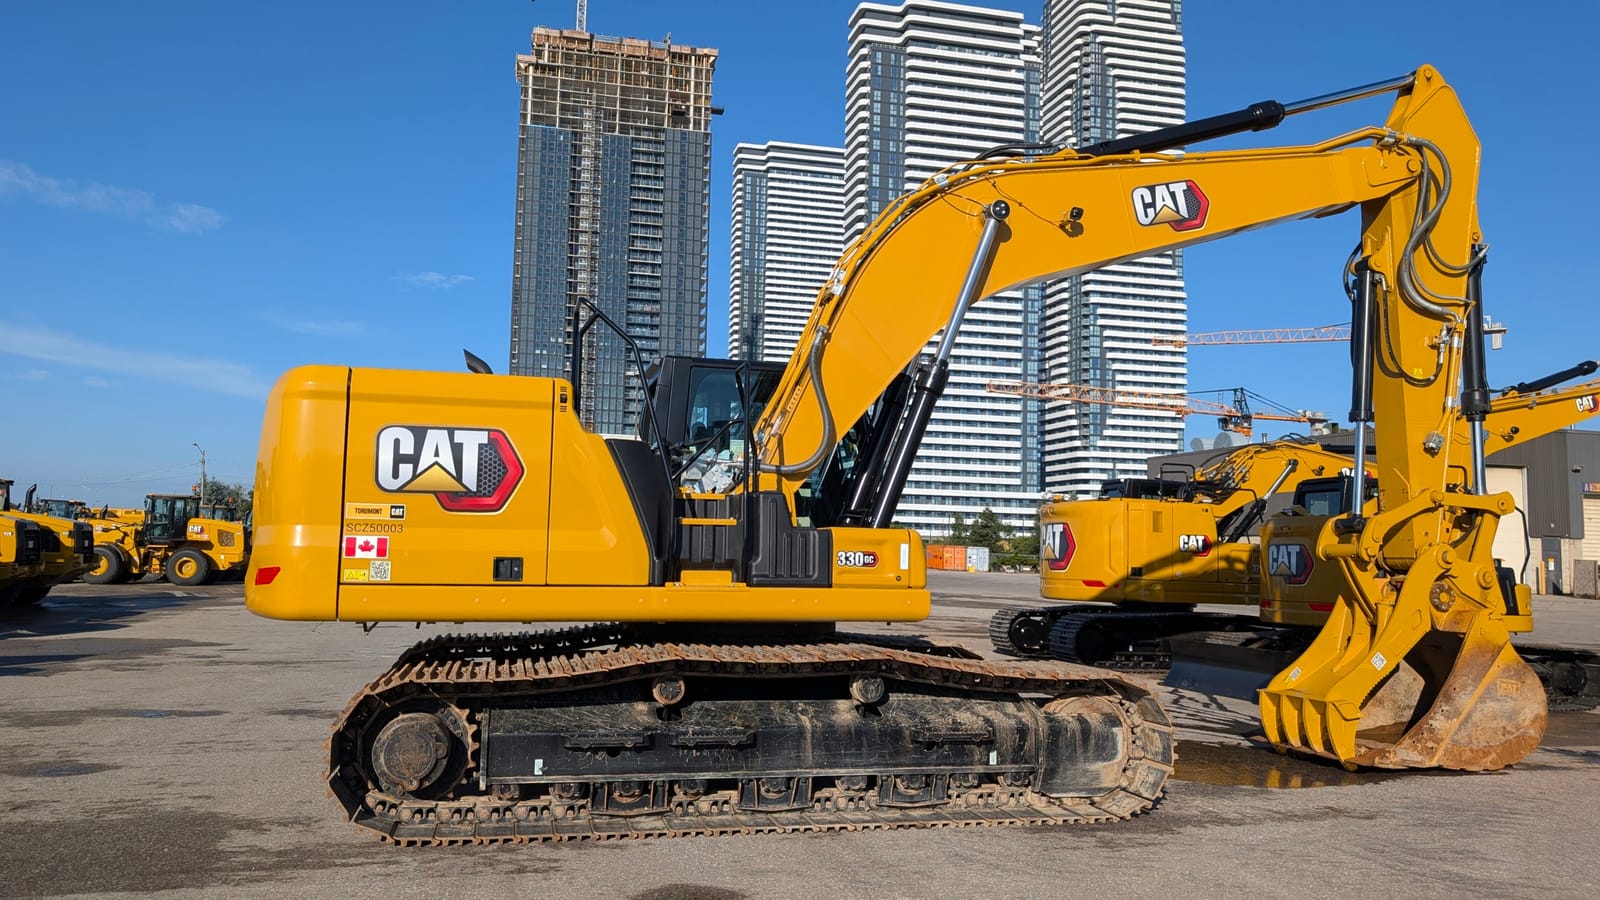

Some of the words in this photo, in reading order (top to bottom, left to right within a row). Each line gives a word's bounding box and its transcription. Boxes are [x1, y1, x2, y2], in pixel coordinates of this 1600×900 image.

[1132, 181, 1189, 225] CAT
[1575, 395, 1594, 412] CAT
[378, 426, 489, 492] CAT
[346, 522, 404, 533] SCZ50003
[1179, 534, 1205, 552] CAT
[1269, 544, 1300, 576] CAT
